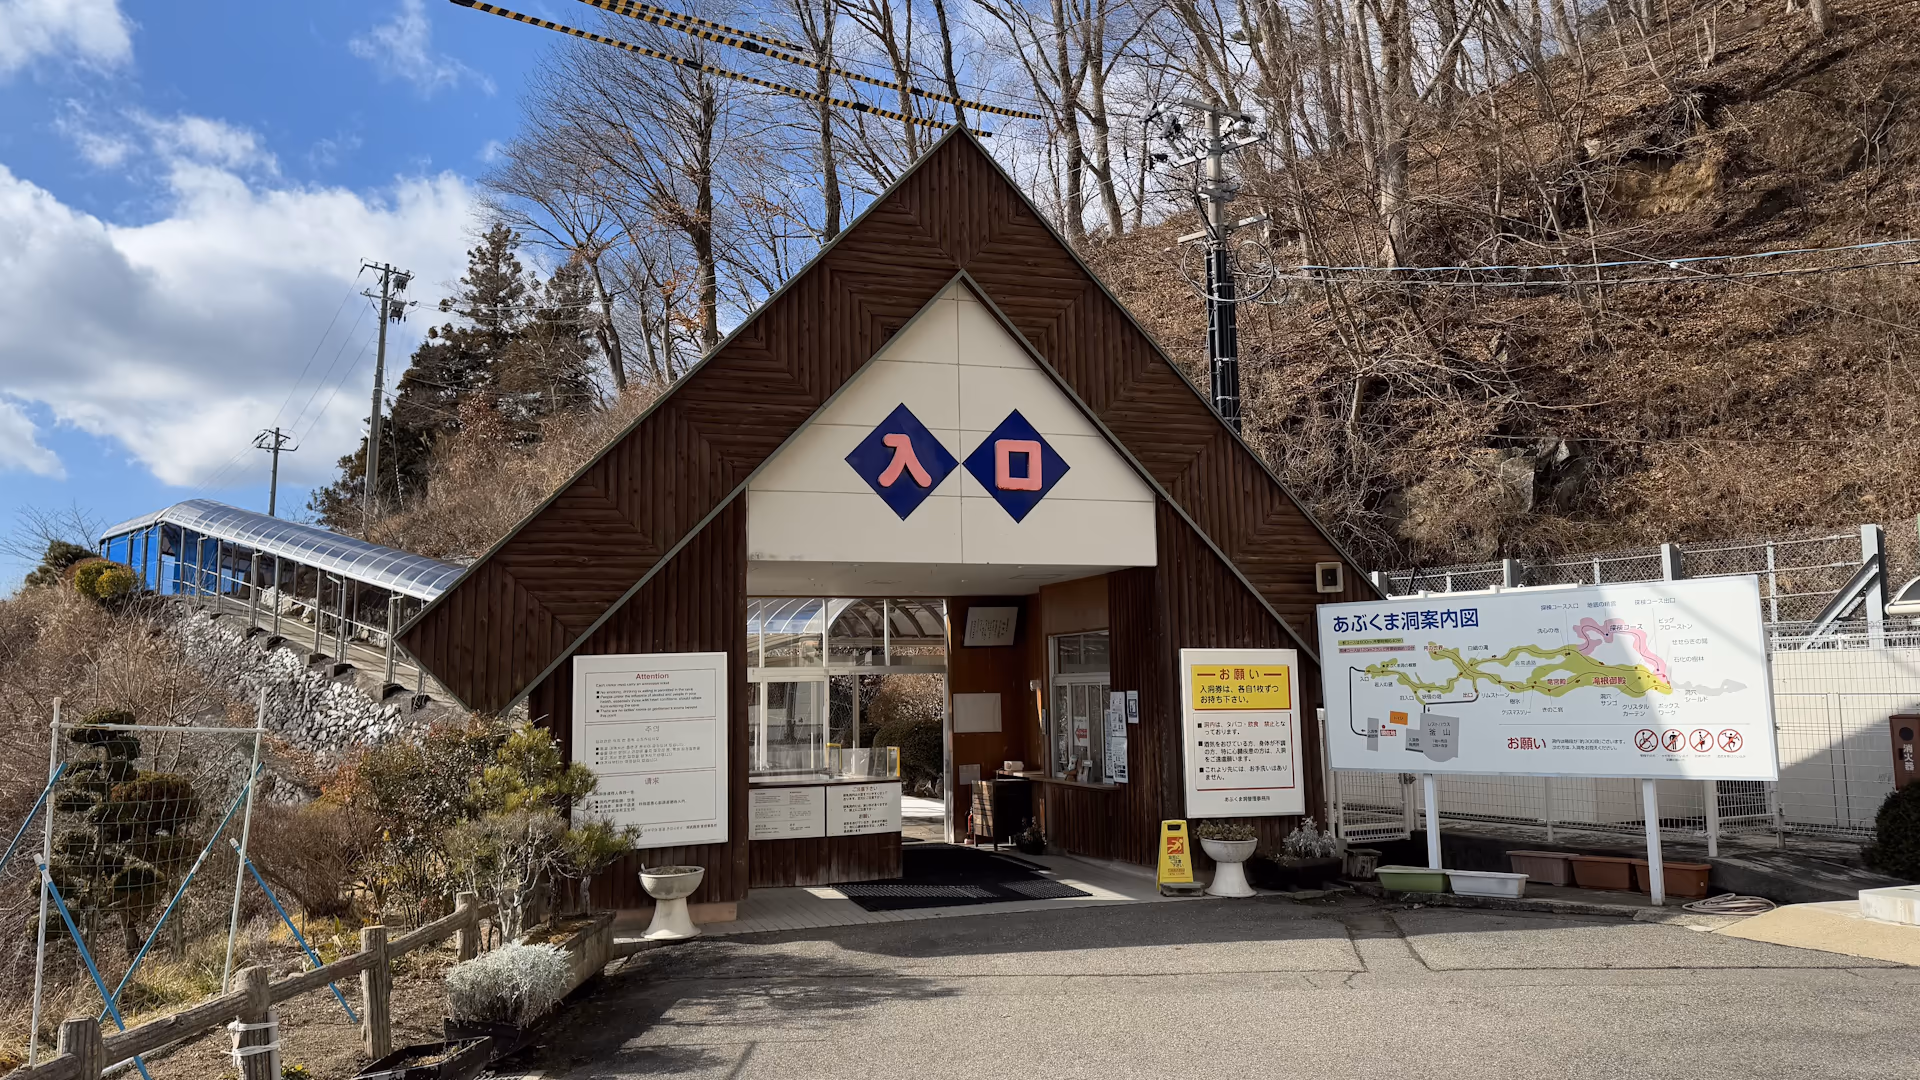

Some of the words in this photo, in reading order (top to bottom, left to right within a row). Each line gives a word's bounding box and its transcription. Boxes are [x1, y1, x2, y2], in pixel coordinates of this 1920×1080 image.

[877, 433, 1043, 491] 入口
[1333, 608, 1479, 633] あぶくま洞案内図
[1219, 668, 1260, 681] お願い
[1200, 684, 1279, 694] 入洞券は、各自1枚ずつ
[1200, 695, 1249, 704] お持ち下さい。
[1507, 737, 1547, 750] お願い
[1903, 744, 1915, 771] 消火器
